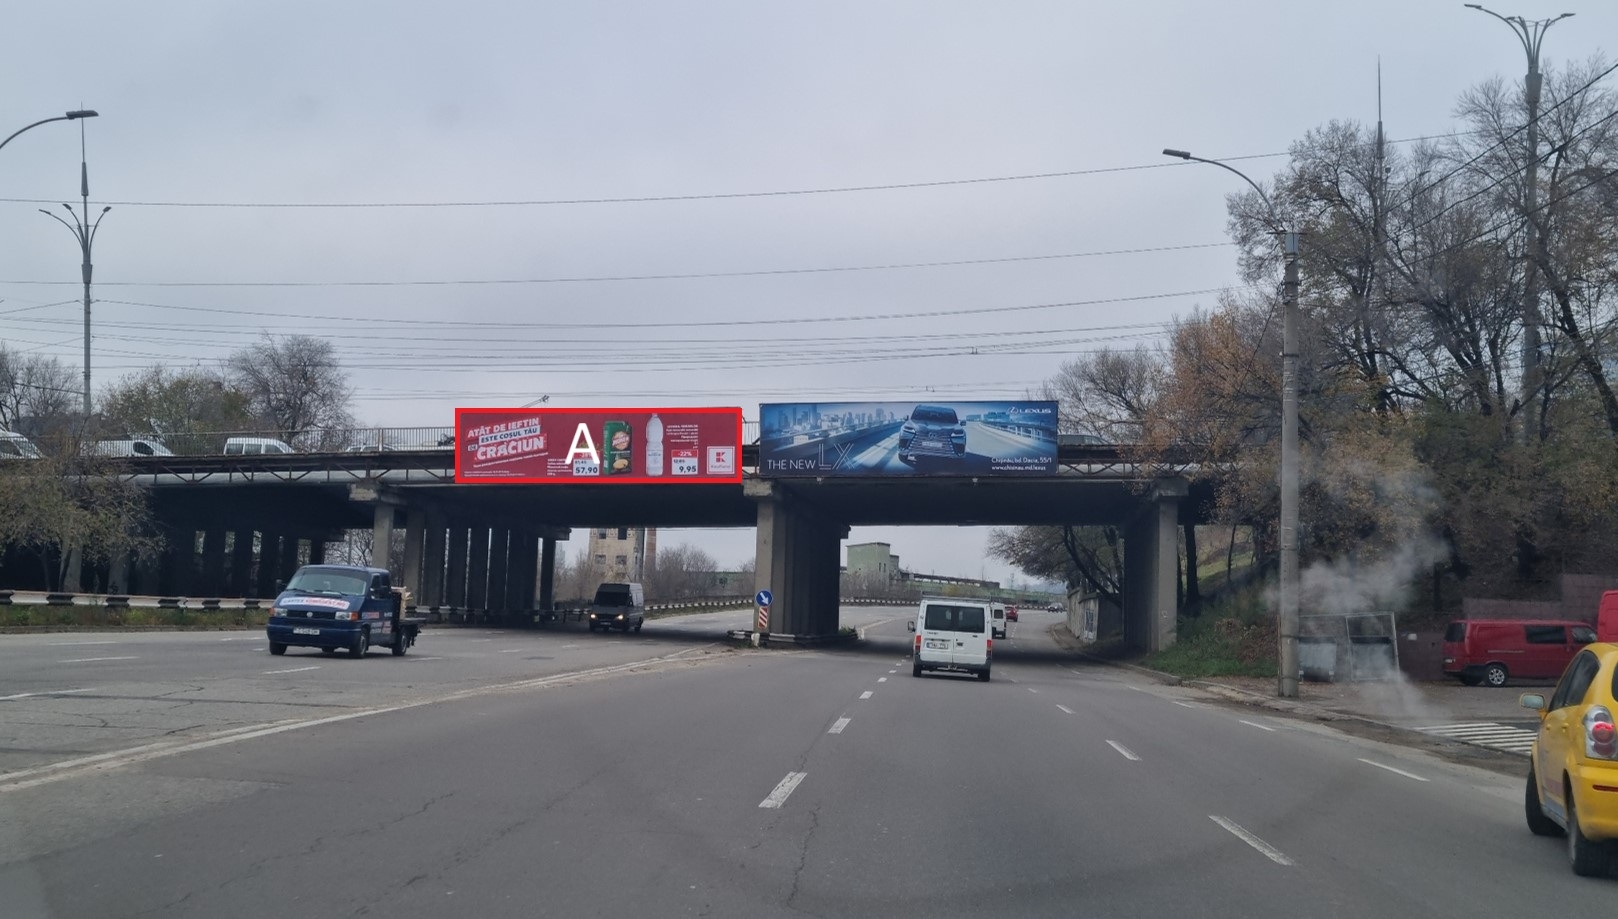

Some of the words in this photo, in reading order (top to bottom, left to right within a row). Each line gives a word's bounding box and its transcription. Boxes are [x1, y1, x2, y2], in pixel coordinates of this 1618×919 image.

[468, 425, 491, 438] ATÂT
[493, 424, 506, 433] DE
[508, 418, 539, 430] IEFTIN
[481, 435, 498, 443] ESTE
[524, 427, 537, 435] TĂU
[477, 436, 544, 460] CRĂCIUN
[767, 459, 787, 470] THE
[790, 459, 816, 470] NEW
[818, 443, 854, 470] LX
[575, 466, 598, 474] 57,90
[679, 466, 696, 474] 9,95
